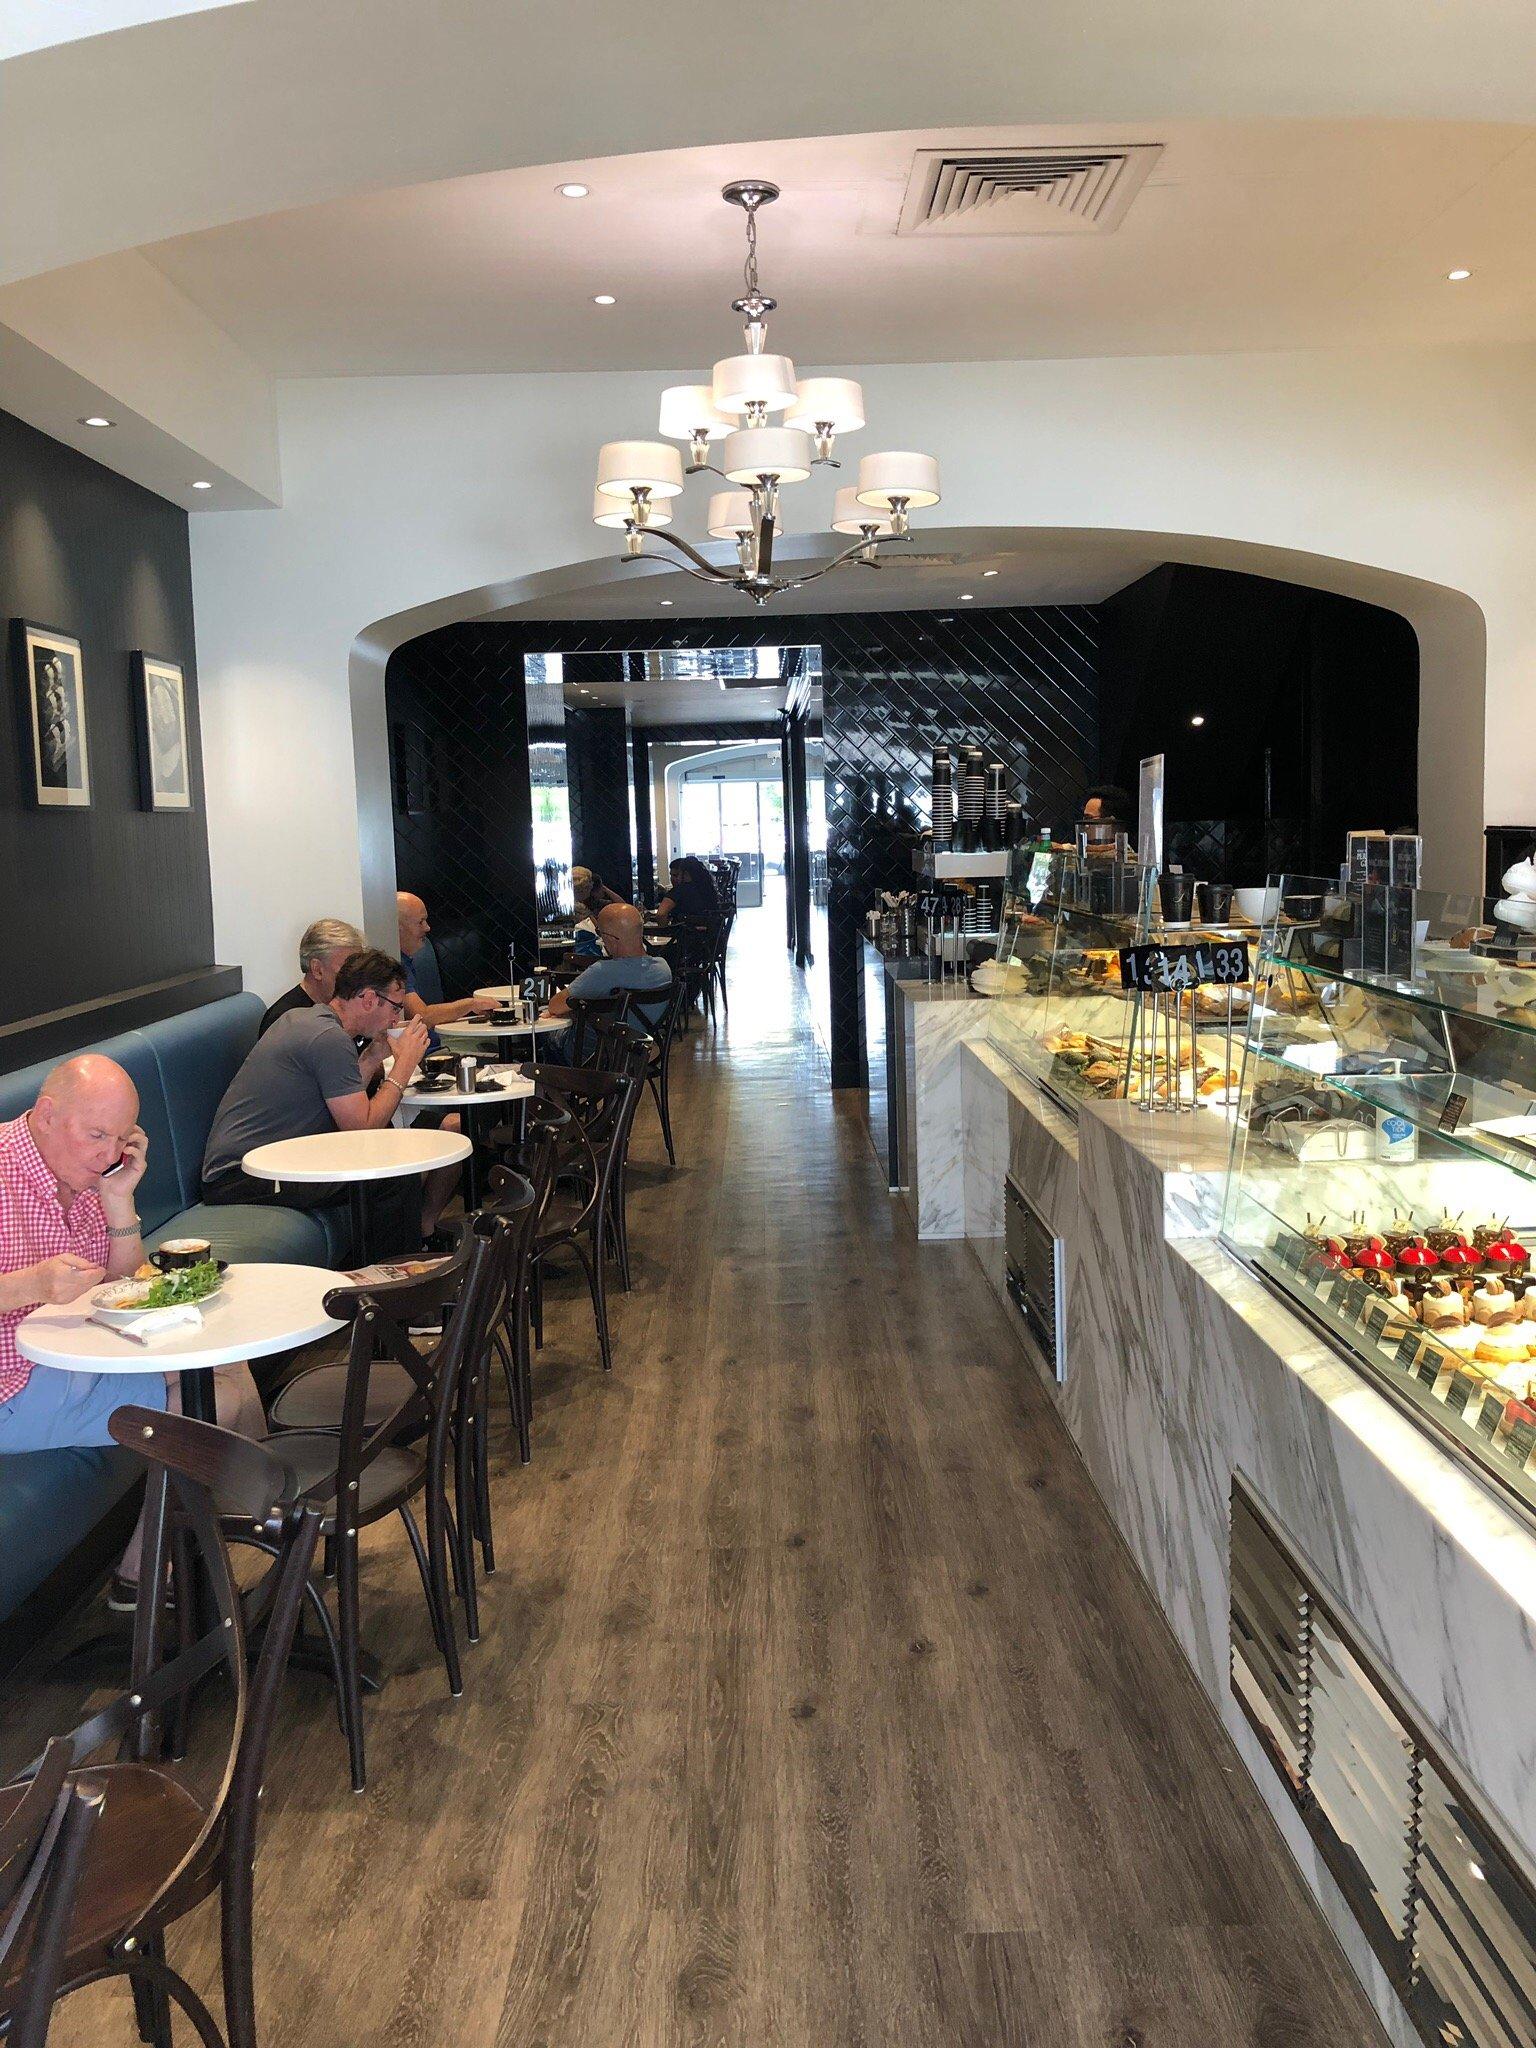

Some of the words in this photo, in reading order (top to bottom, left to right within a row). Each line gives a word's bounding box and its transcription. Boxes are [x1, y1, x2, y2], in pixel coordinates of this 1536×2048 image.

[921, 896, 939, 914] 47
[509, 942, 514, 956] 1
[1216, 948, 1244, 977] 33
[523, 977, 545, 998] 21
